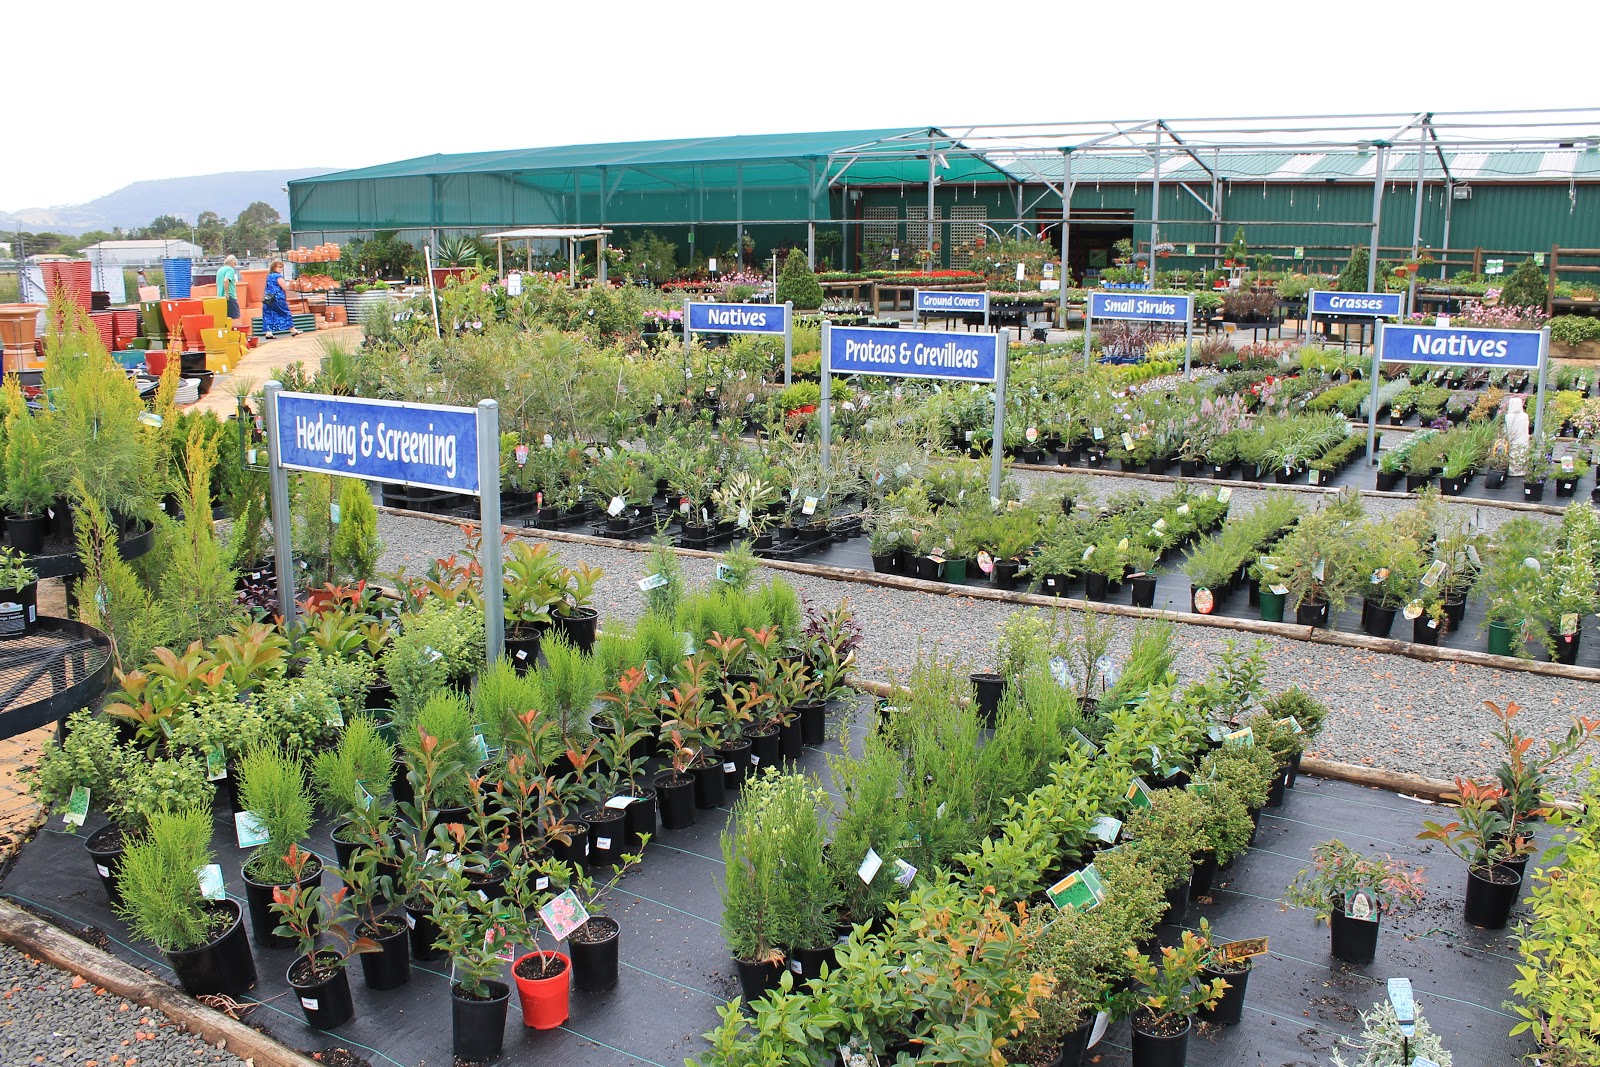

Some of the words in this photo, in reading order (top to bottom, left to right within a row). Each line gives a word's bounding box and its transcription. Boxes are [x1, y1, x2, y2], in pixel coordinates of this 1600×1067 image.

[923, 295, 953, 307] Ground
[954, 296, 980, 307] Covers
[1104, 299, 1135, 313] Small
[1136, 299, 1176, 315] Shrubs
[1329, 296, 1383, 310] Grasses
[708, 308, 767, 327] Natives
[845, 339, 896, 364] Proteas
[899, 342, 912, 365] &
[914, 342, 979, 369] Grevilleas
[1412, 334, 1508, 358] Natives
[296, 412, 356, 466] Hedging
[360, 421, 374, 458] &
[376, 422, 457, 479] Screening
